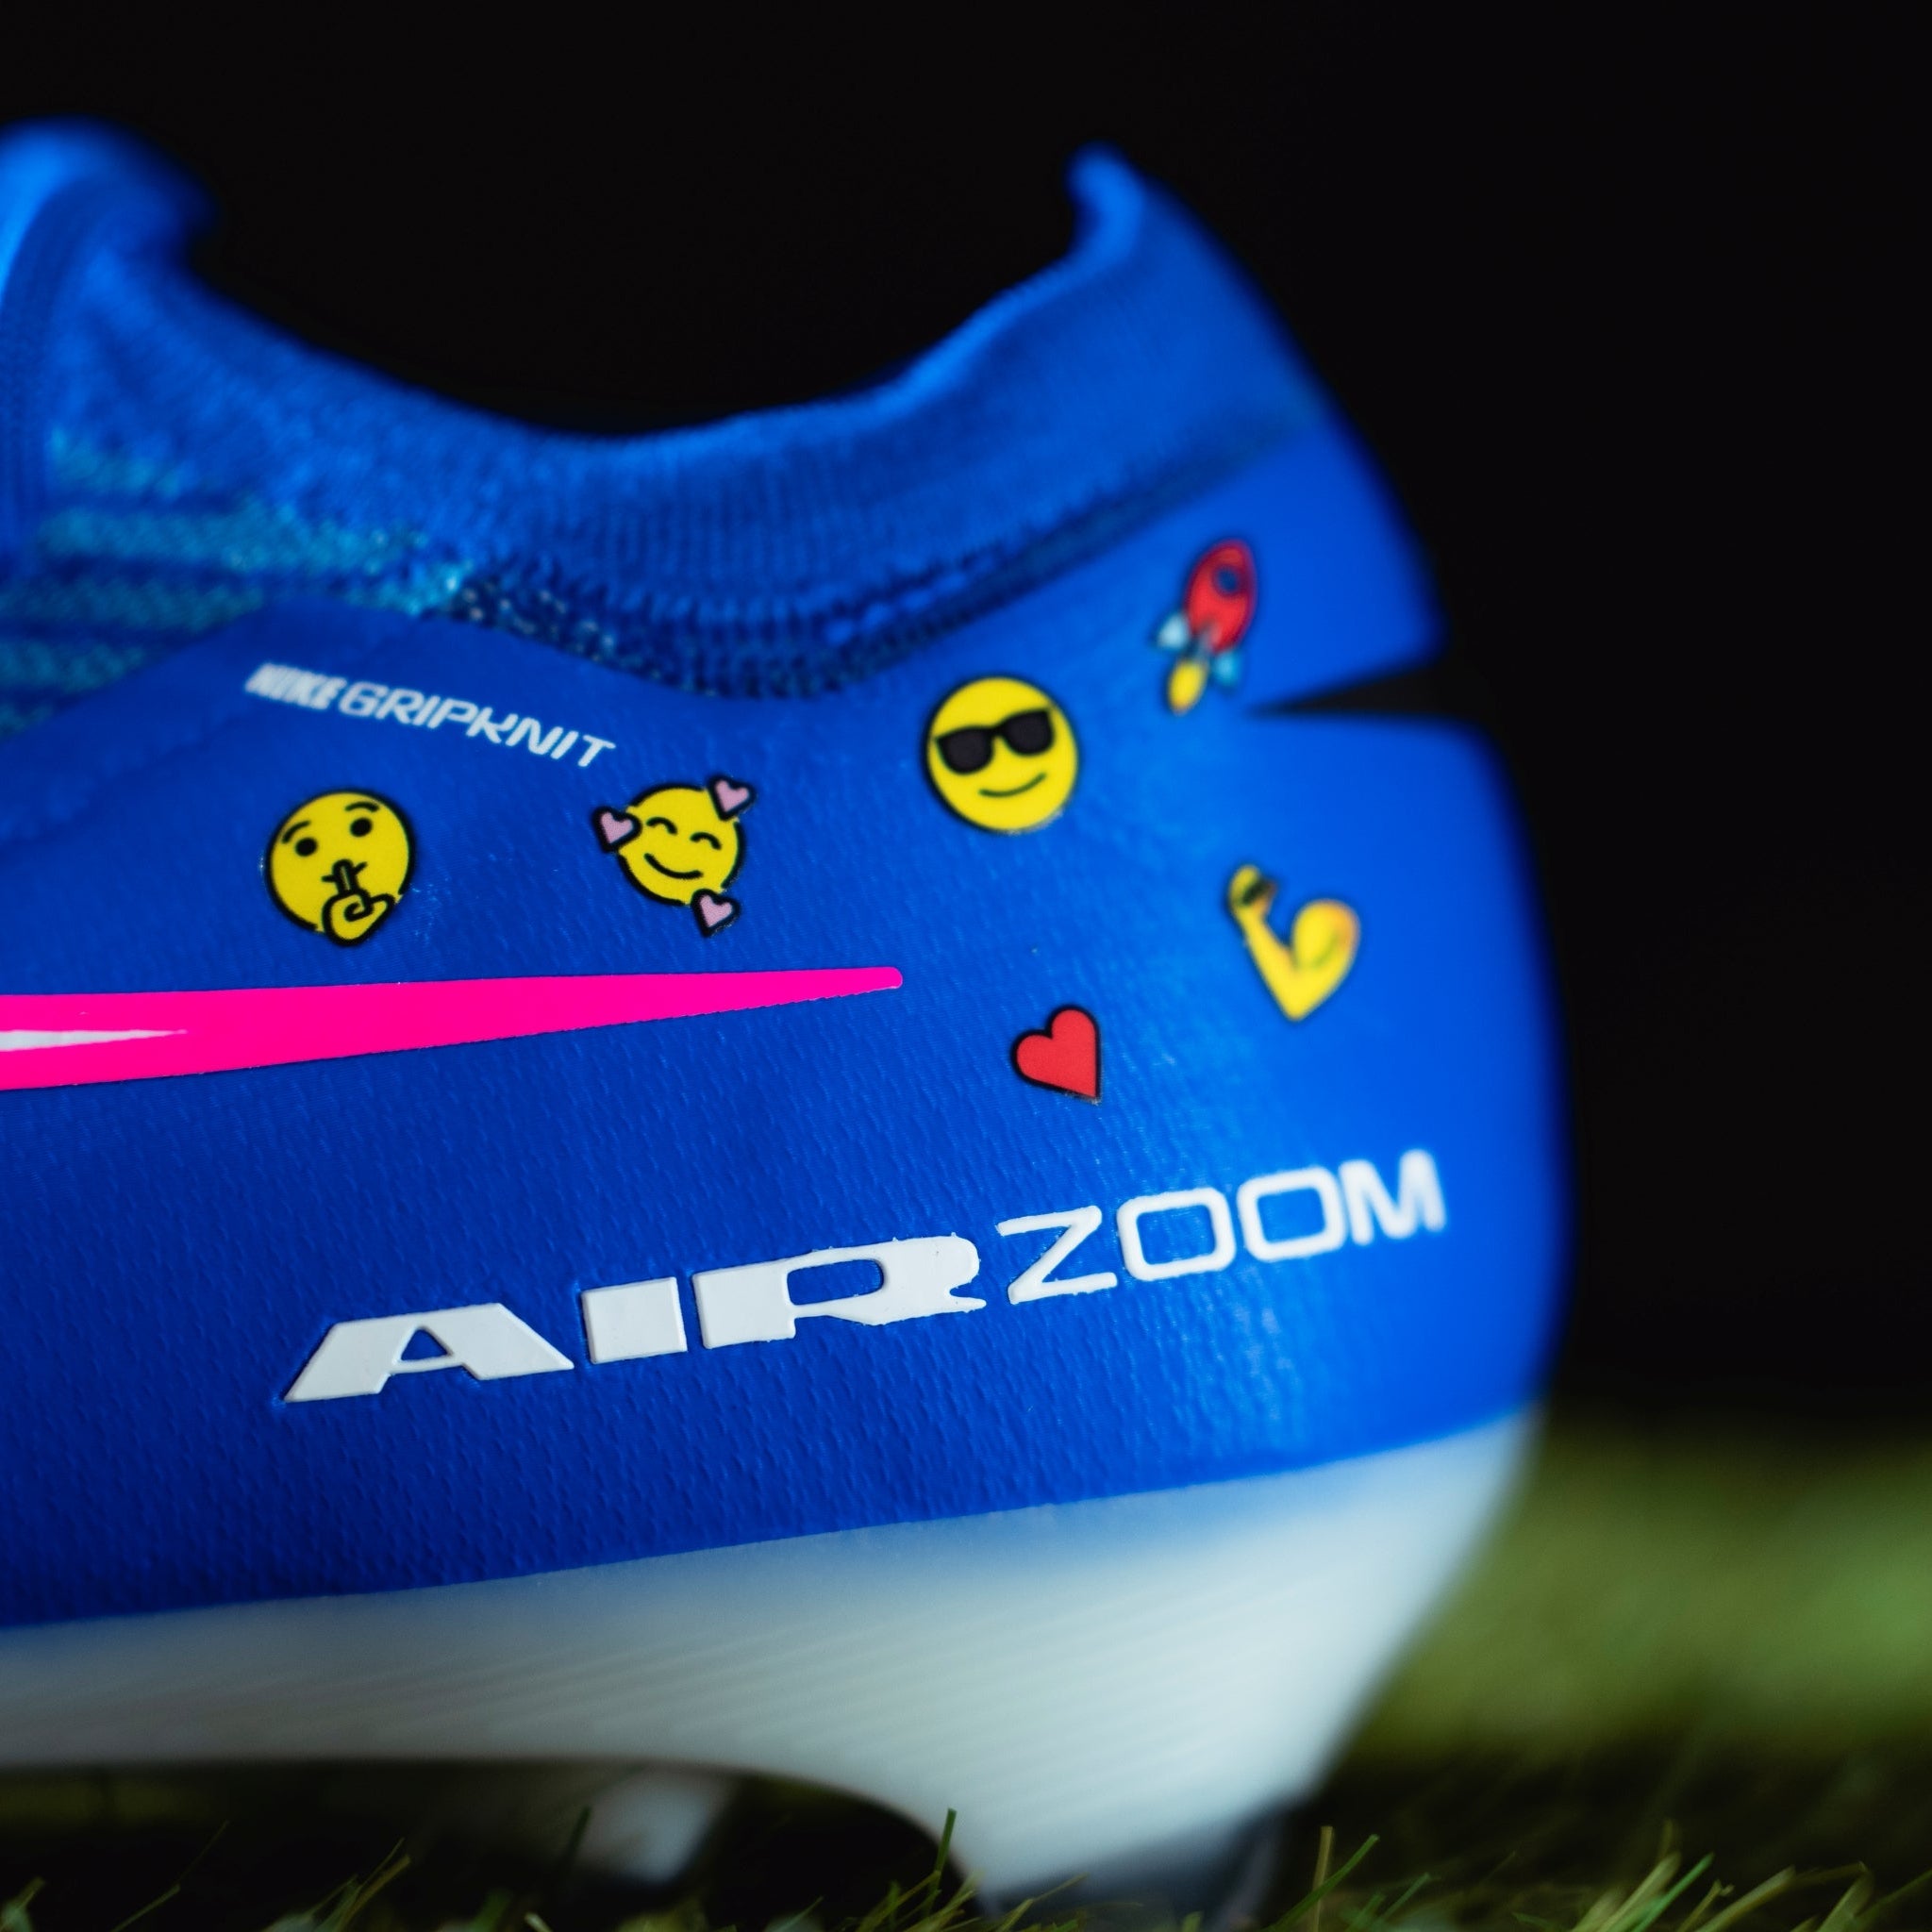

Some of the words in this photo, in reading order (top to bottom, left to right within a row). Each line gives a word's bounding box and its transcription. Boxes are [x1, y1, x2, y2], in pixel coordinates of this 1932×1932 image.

[338, 681, 616, 768] GRIPKNIT
[283, 1232, 987, 1403] AIR
[996, 1149, 1445, 1306] ZOOM
